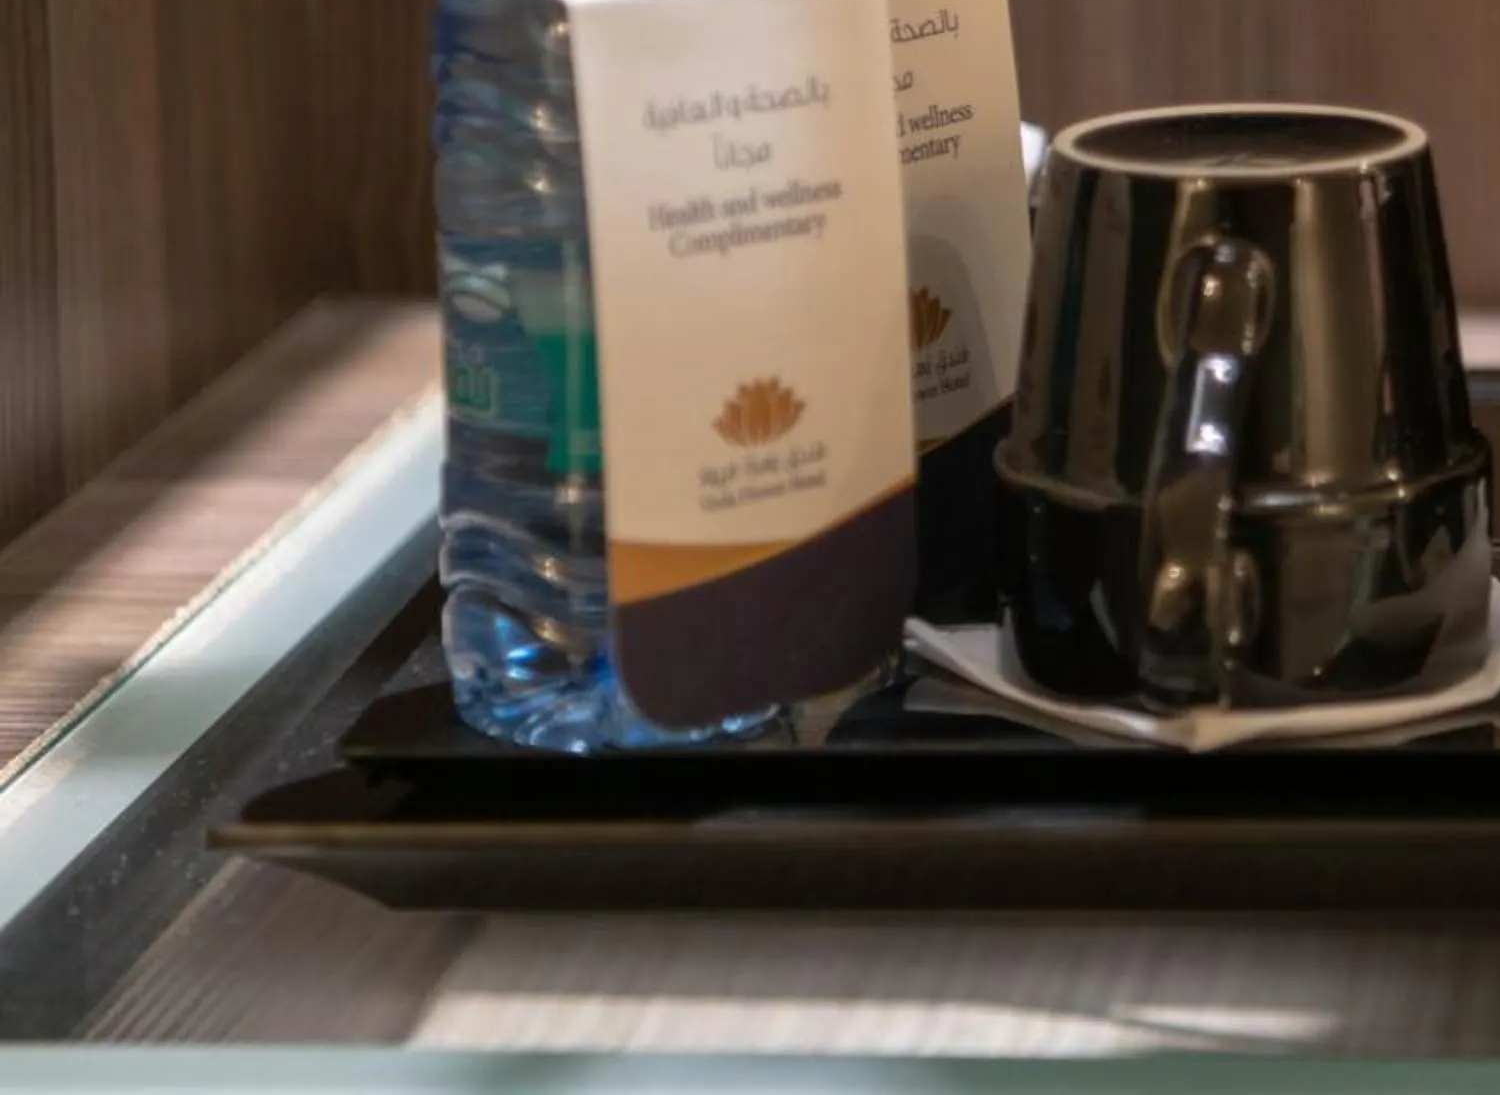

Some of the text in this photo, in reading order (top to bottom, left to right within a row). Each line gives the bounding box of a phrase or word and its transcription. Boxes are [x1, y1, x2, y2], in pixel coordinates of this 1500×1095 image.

[908, 104, 973, 133] wellness
[647, 179, 843, 231] Health and wellness
[668, 213, 826, 259] Complimentary
